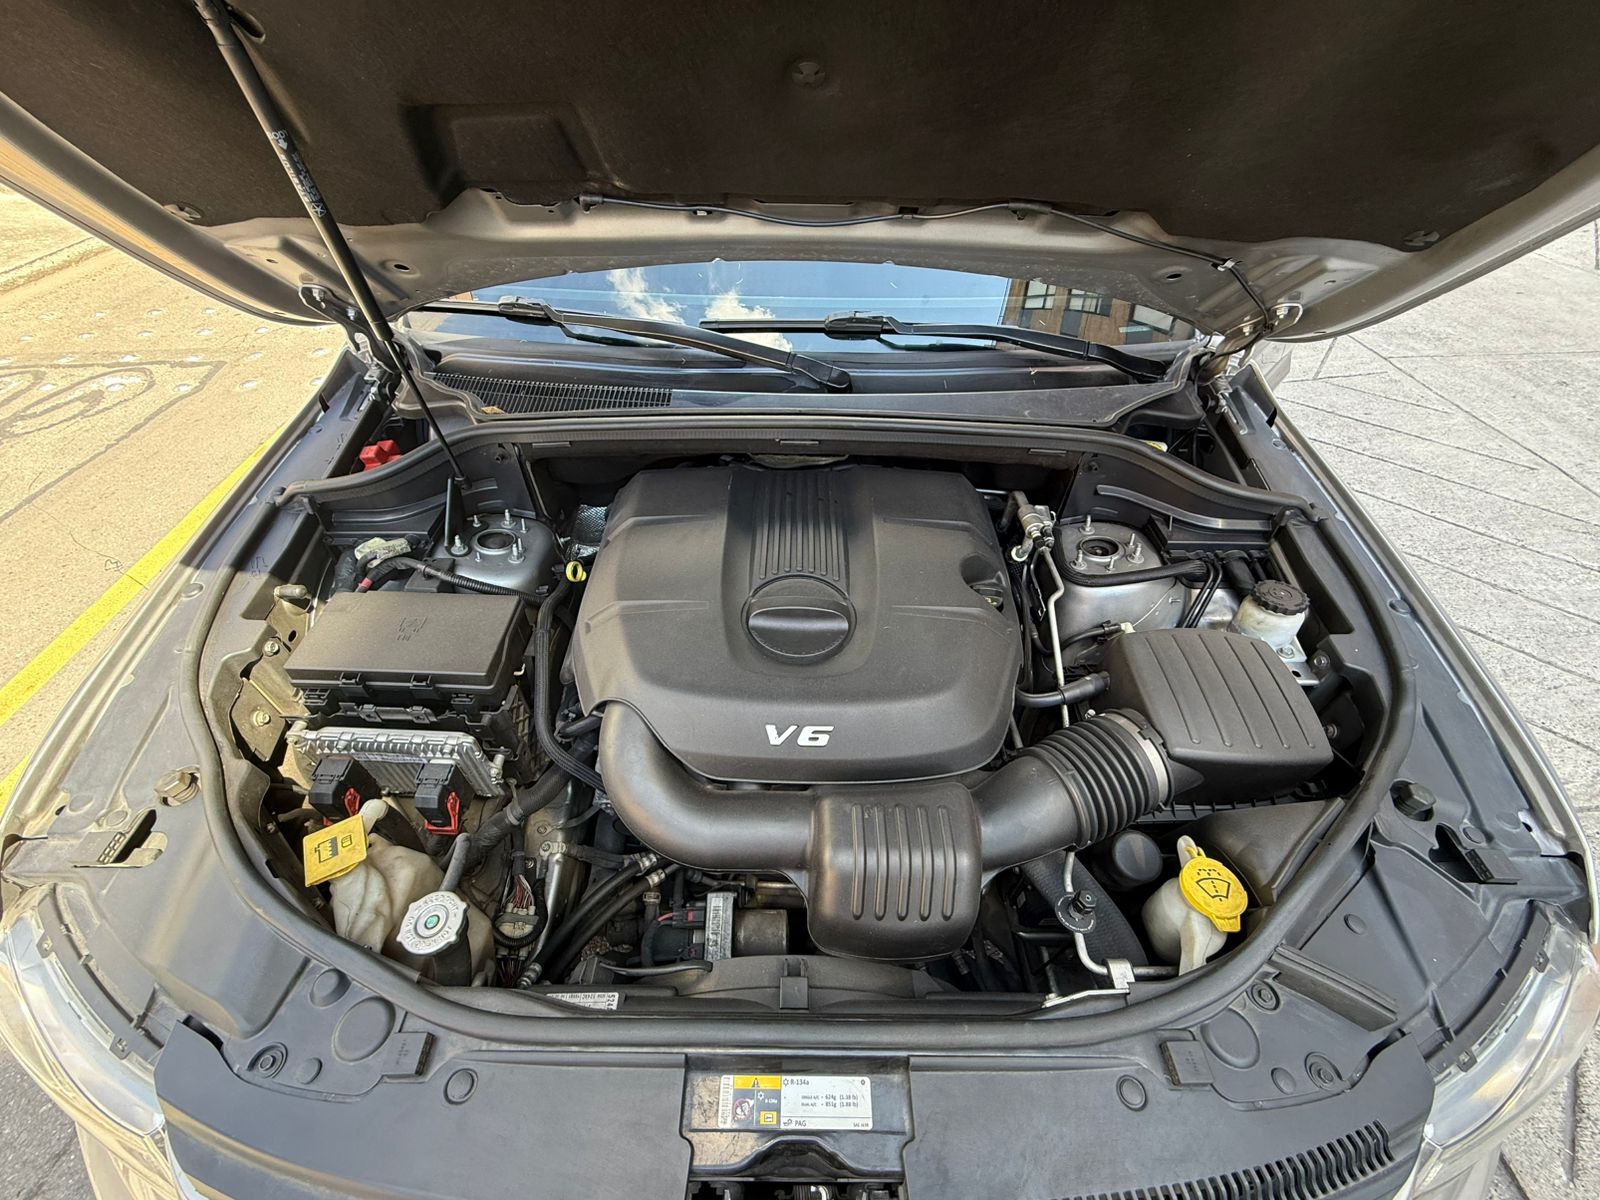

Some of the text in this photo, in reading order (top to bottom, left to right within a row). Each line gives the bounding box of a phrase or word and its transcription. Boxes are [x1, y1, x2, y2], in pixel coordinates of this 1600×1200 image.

[765, 724, 835, 747] V6
[790, 1078, 810, 1086] R-134a
[794, 1119, 807, 1127] PAG
